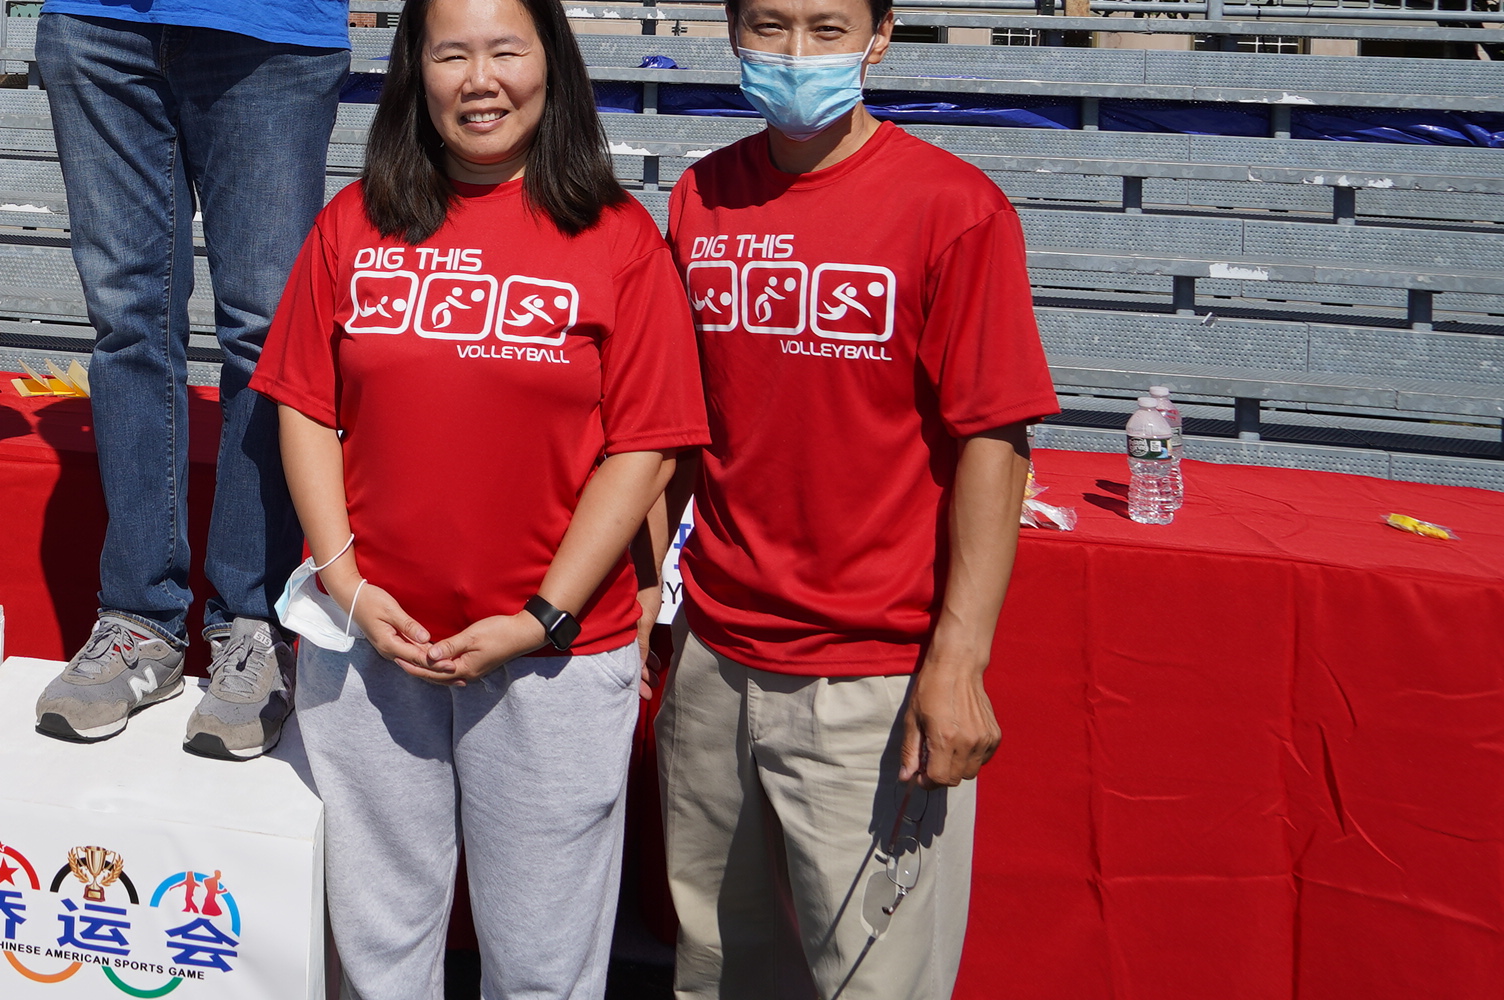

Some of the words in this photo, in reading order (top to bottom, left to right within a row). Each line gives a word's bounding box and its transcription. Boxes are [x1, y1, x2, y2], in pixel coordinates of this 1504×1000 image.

[353, 246, 405, 269] DIG
[415, 247, 482, 272] THIS
[691, 234, 729, 259] DIG
[735, 233, 795, 259] THIS
[456, 344, 571, 364] VOLLEYBALL
[779, 339, 893, 361] VOLLEYBALL
[45, 948, 110, 966] AMERICAN
[114, 958, 164, 975] SPORTS
[168, 966, 205, 980] GAME
